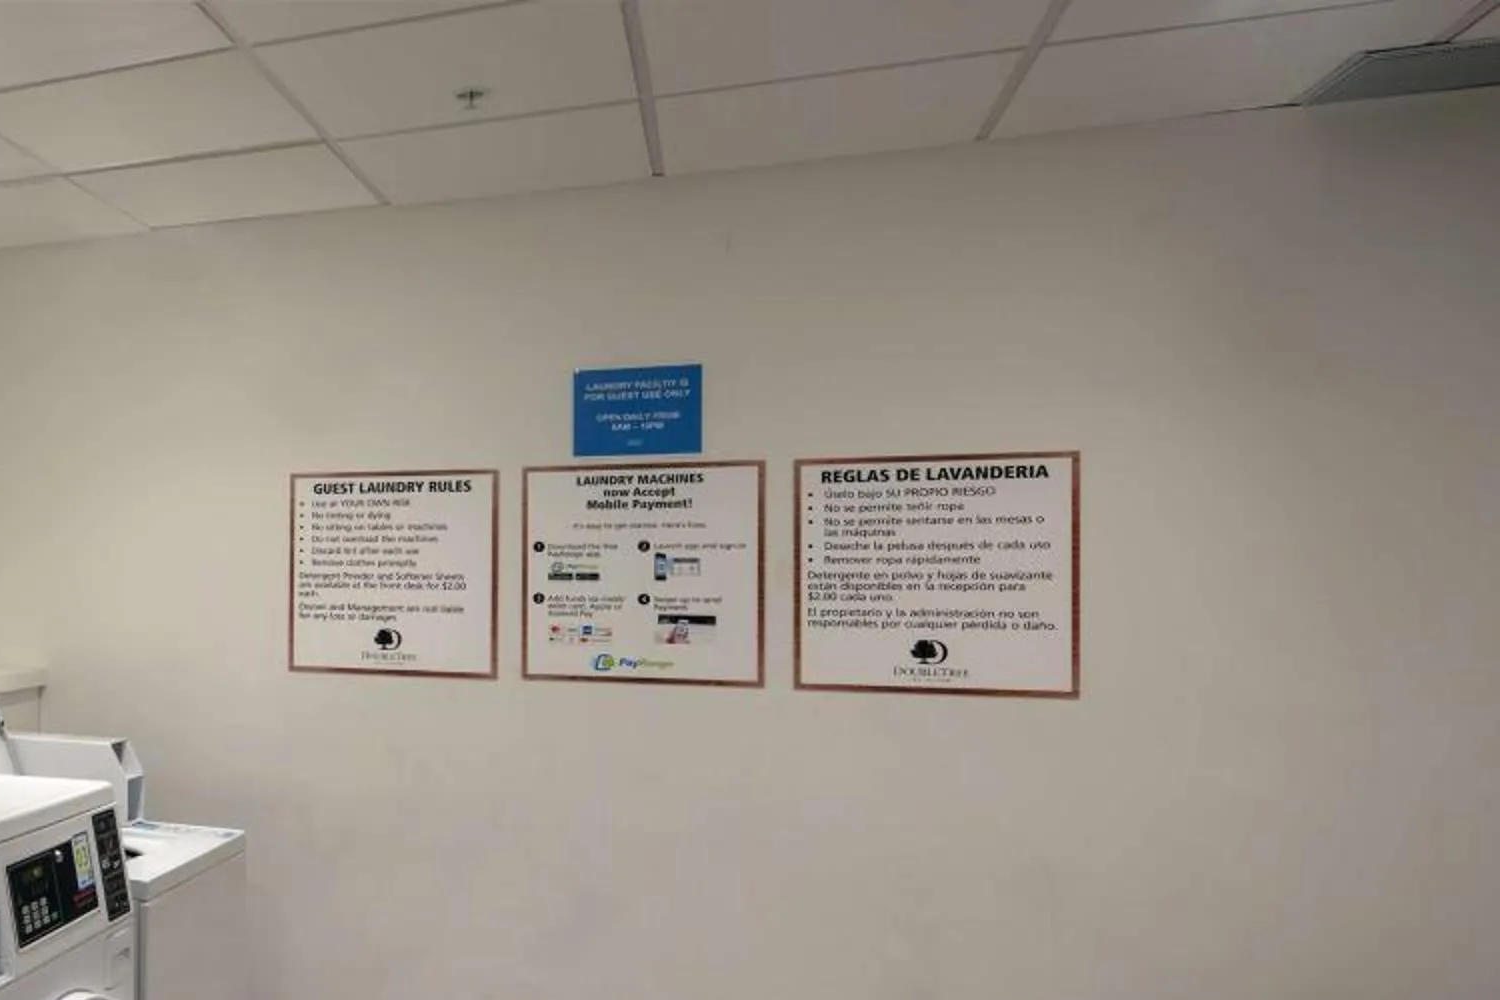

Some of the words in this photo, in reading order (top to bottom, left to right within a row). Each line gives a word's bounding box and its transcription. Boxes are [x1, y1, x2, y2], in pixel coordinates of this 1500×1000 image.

[576, 475, 634, 487] LAUNDRY
[637, 473, 705, 485] MACHINES
[821, 469, 891, 484] REGLAS
[896, 467, 921, 481] DE
[925, 465, 1049, 481] LAVANDERIA
[313, 482, 355, 495] GUEST
[359, 480, 425, 495] LAUNDRY
[429, 479, 472, 493] RULES
[603, 489, 630, 497] now
[633, 487, 676, 499] Accept
[857, 488, 883, 500] bajo
[885, 488, 901, 498] SU
[903, 487, 949, 497] PROPIO
[951, 486, 997, 497] RIESGO
[340, 499, 365, 508] YOUR
[586, 499, 629, 510] Mobile
[632, 498, 693, 511] Payment!
[823, 503, 840, 513] No
[858, 502, 902, 514] permite
[937, 502, 965, 513] ropa
[823, 517, 840, 527] No
[858, 517, 902, 528] permite
[956, 516, 973, 525] en
[975, 515, 993, 525] las
[995, 515, 1034, 525] mesas
[887, 540, 925, 552] pelusa
[977, 540, 994, 550] de
[997, 540, 1026, 550] cada
[1029, 541, 1052, 551] uso
[823, 555, 873, 565] Remover
[875, 556, 903, 567] ropa
[807, 570, 871, 581] Detergente
[873, 571, 889, 580] en
[971, 570, 987, 580] de
[839, 581, 903, 593] disponibles
[905, 582, 921, 591] en
[999, 583, 1027, 593] para
[839, 592, 867, 601] cada
[819, 607, 883, 619] propietario
[998, 609, 1015, 620] no
[1017, 610, 1040, 620] son
[881, 620, 901, 631] por
